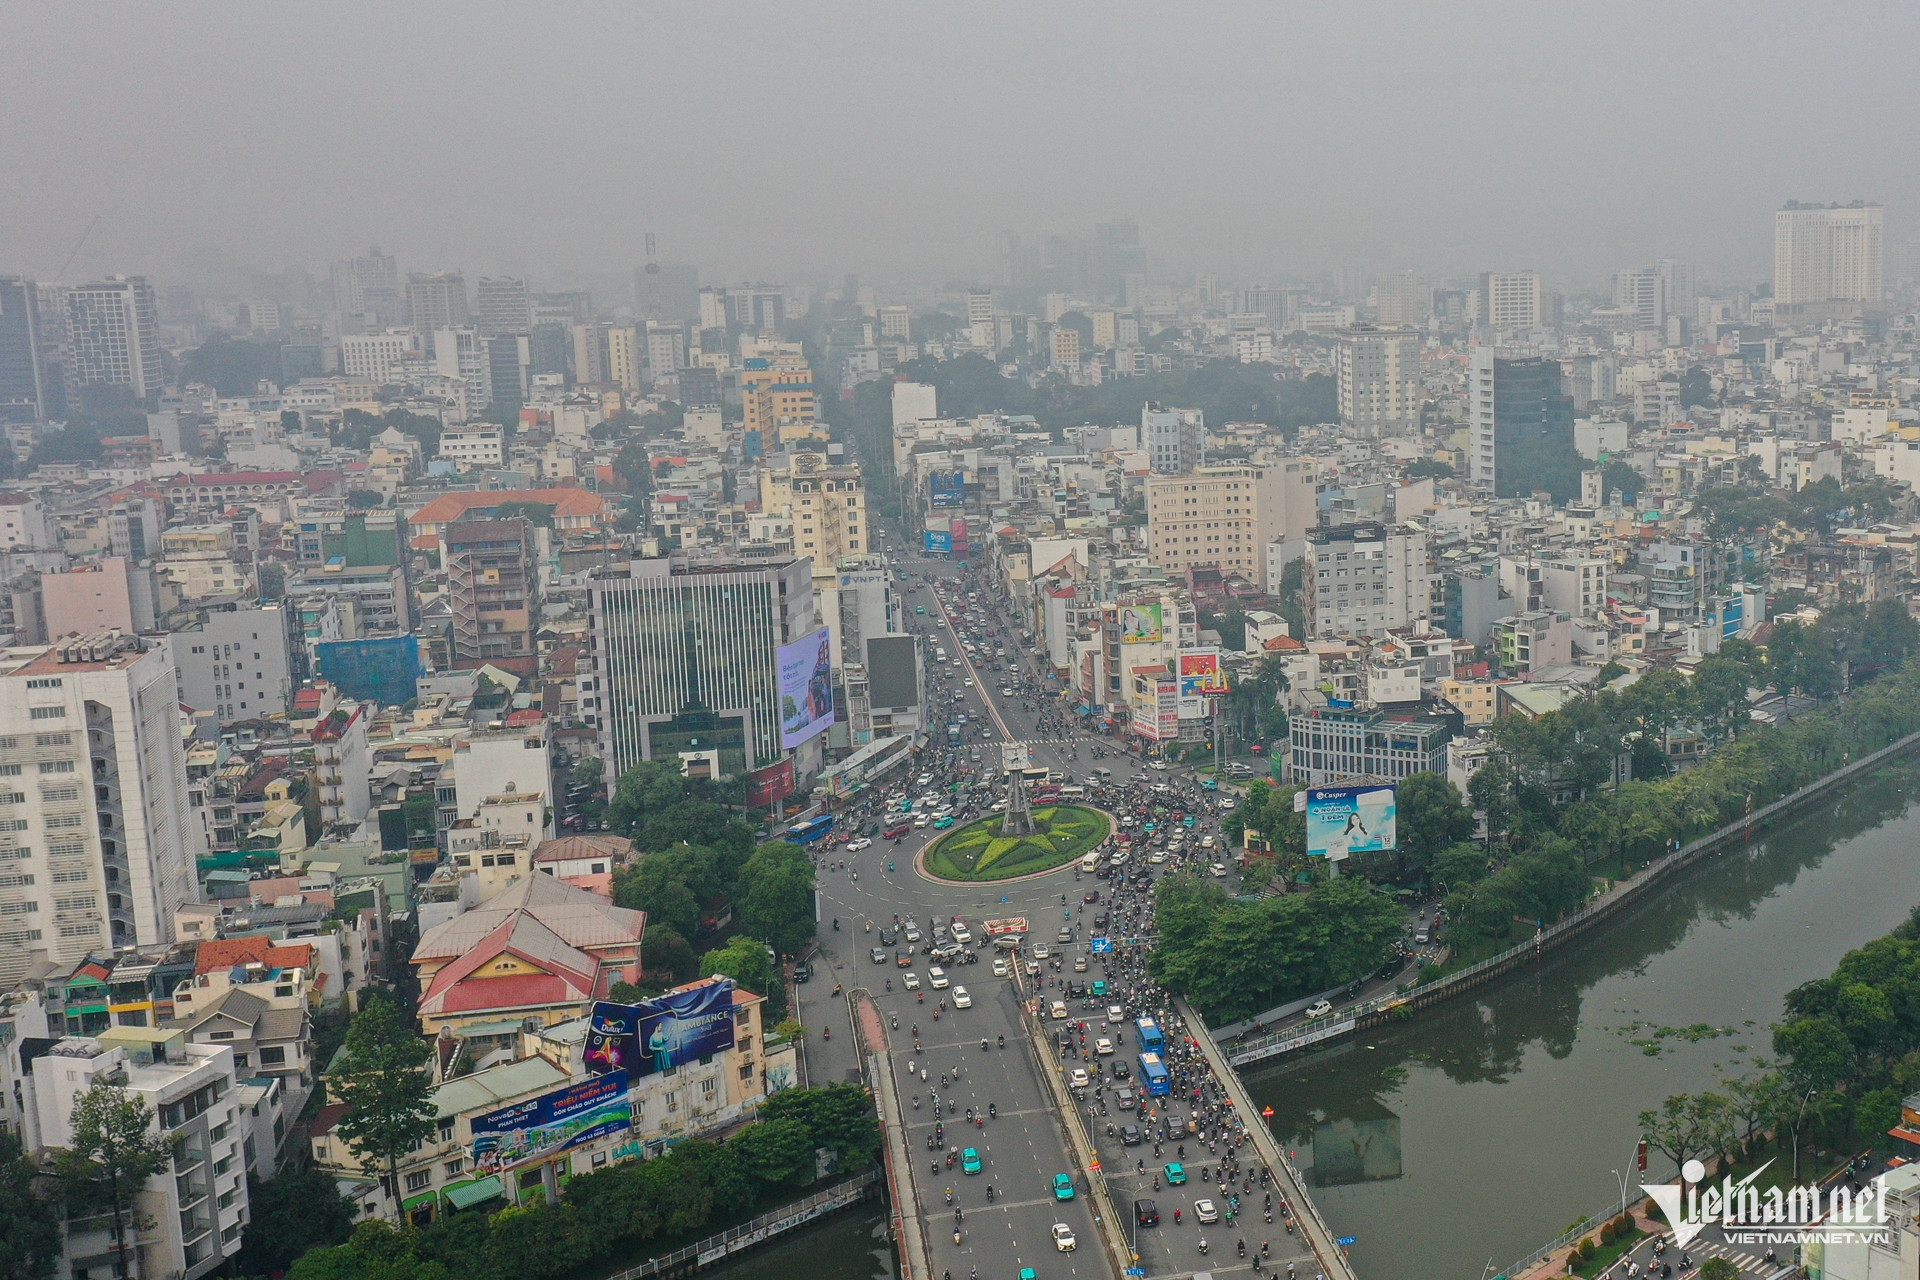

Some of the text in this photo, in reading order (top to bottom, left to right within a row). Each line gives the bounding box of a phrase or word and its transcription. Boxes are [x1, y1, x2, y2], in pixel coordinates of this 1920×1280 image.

[1324, 792, 1347, 800] Casper
[682, 1011, 729, 1032] AMBIANCE
[601, 1023, 620, 1033] Dulux
[498, 1119, 514, 1128] PHAN
